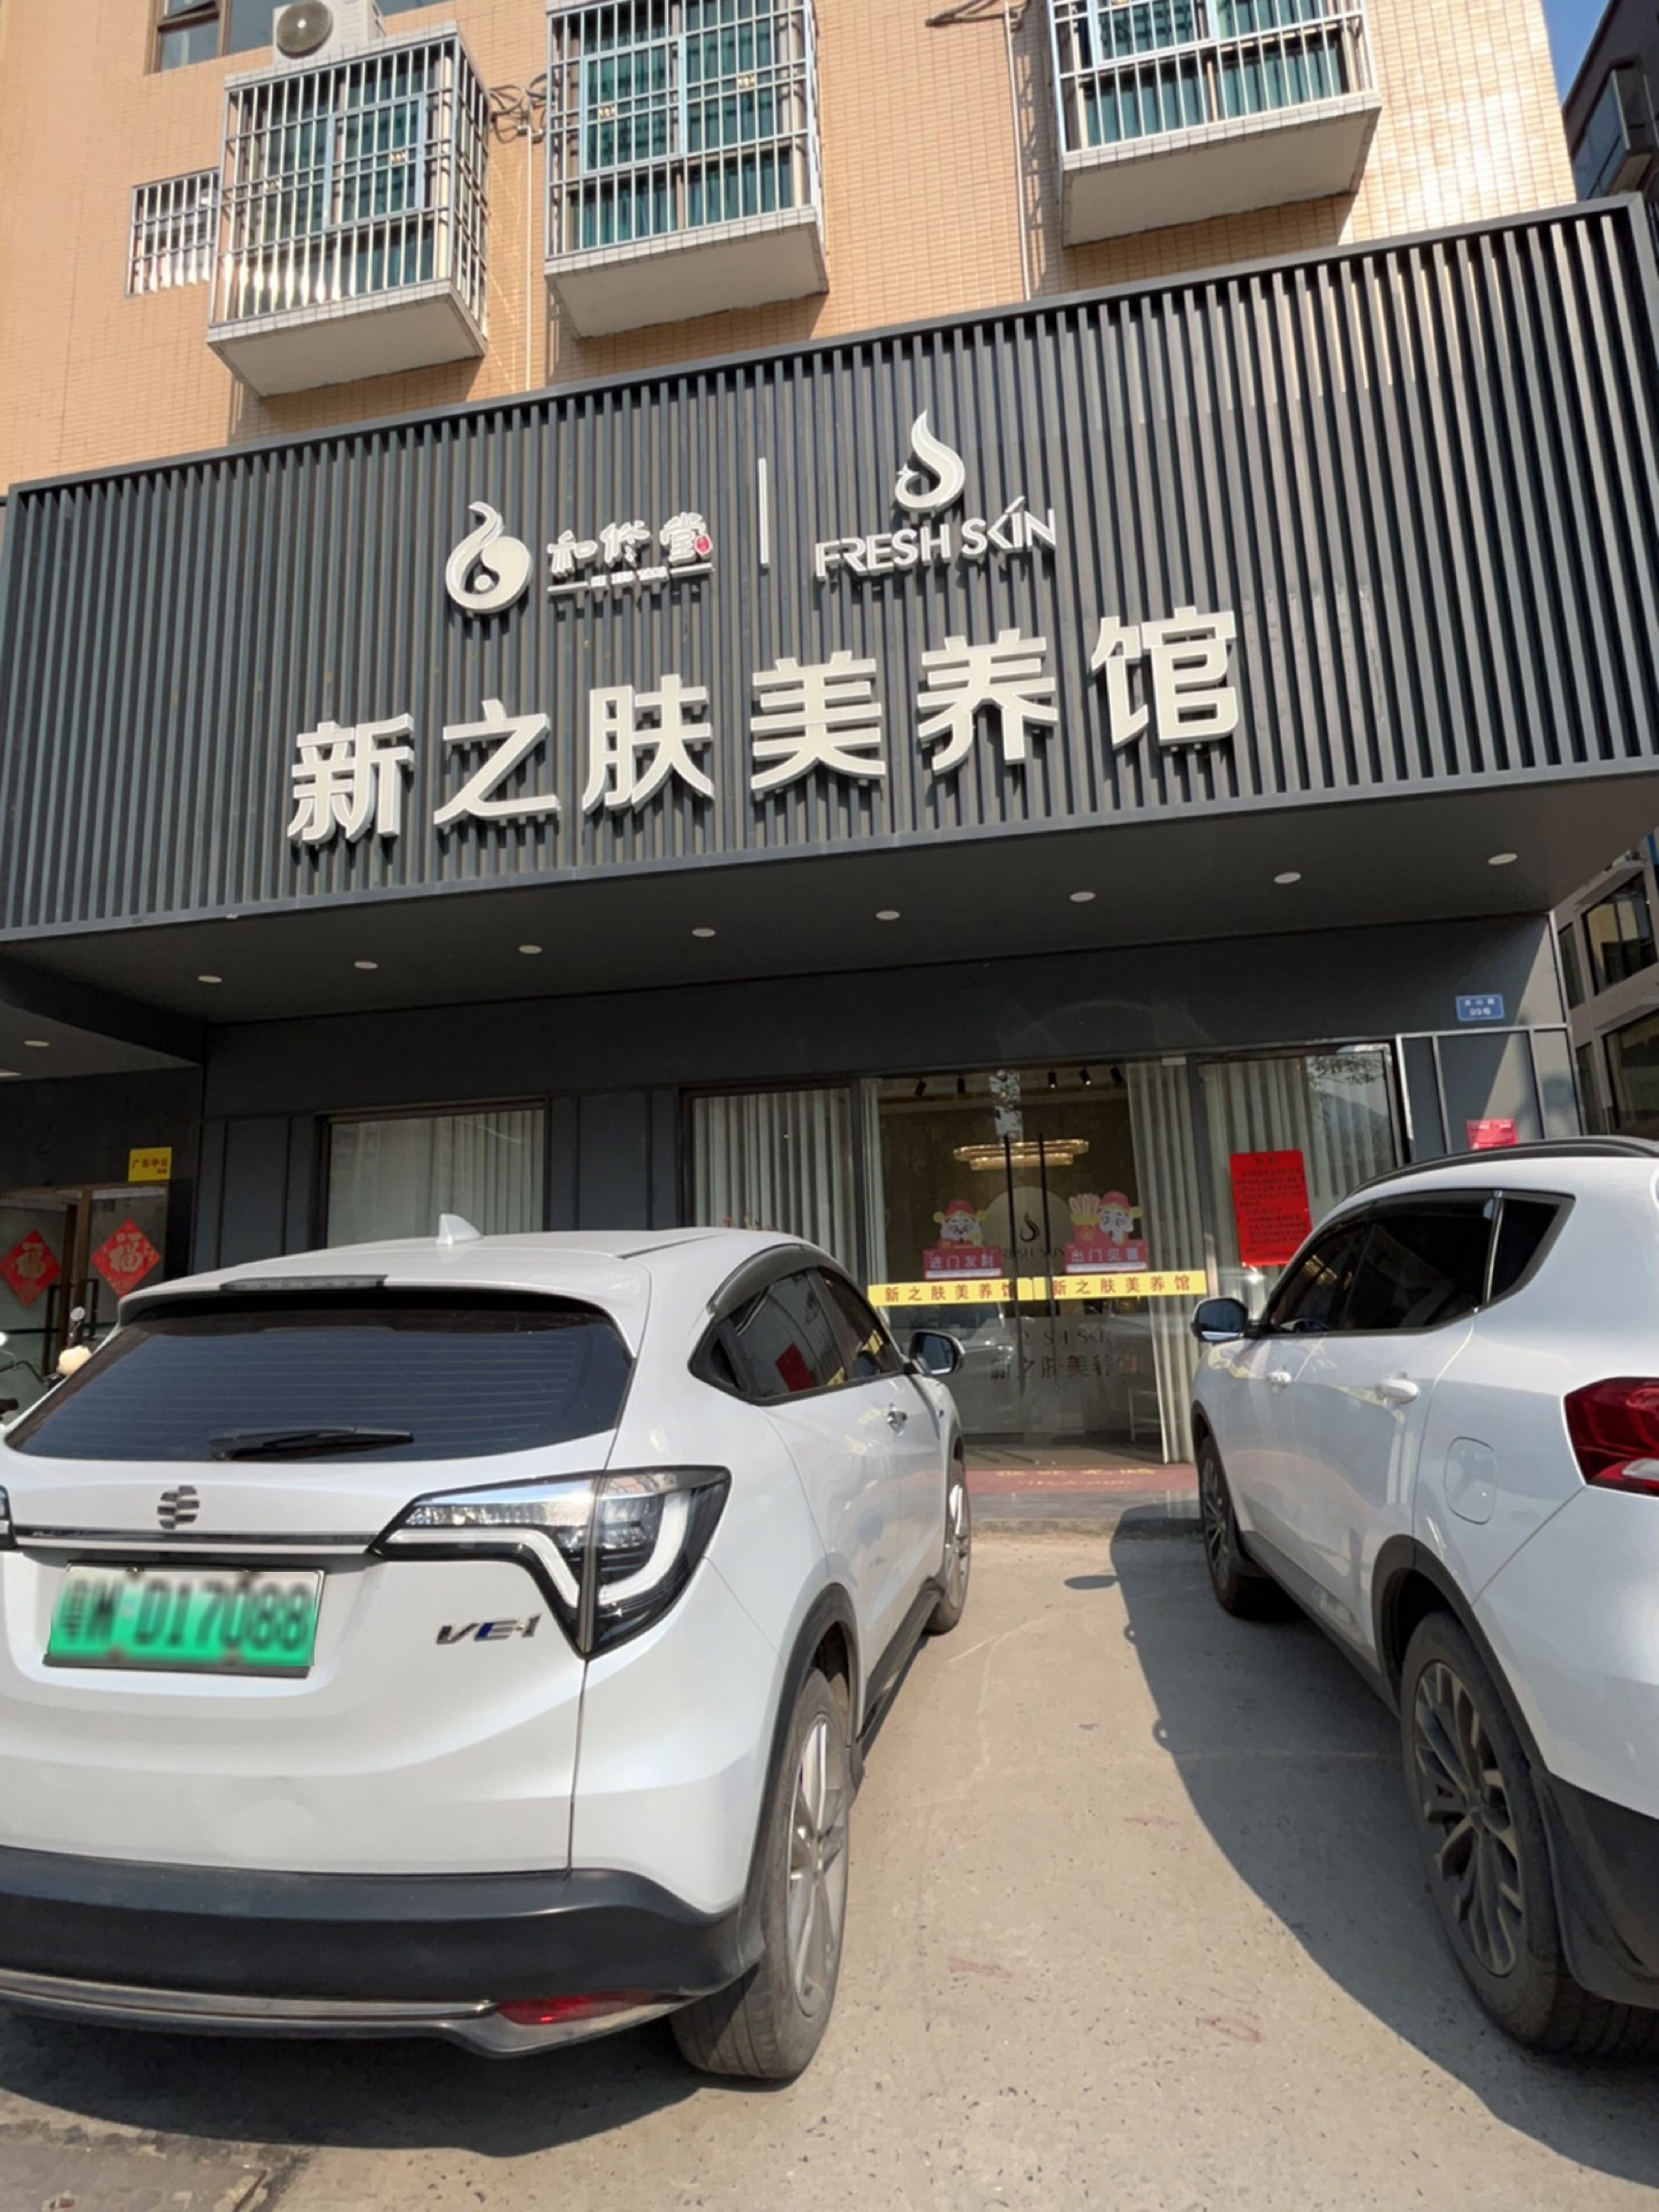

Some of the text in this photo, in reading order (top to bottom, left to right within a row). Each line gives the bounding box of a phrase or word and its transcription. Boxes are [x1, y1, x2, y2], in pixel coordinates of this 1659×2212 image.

[815, 496, 1056, 579] FRESH SKIN
[288, 606, 1239, 844] 新之肤美养馆
